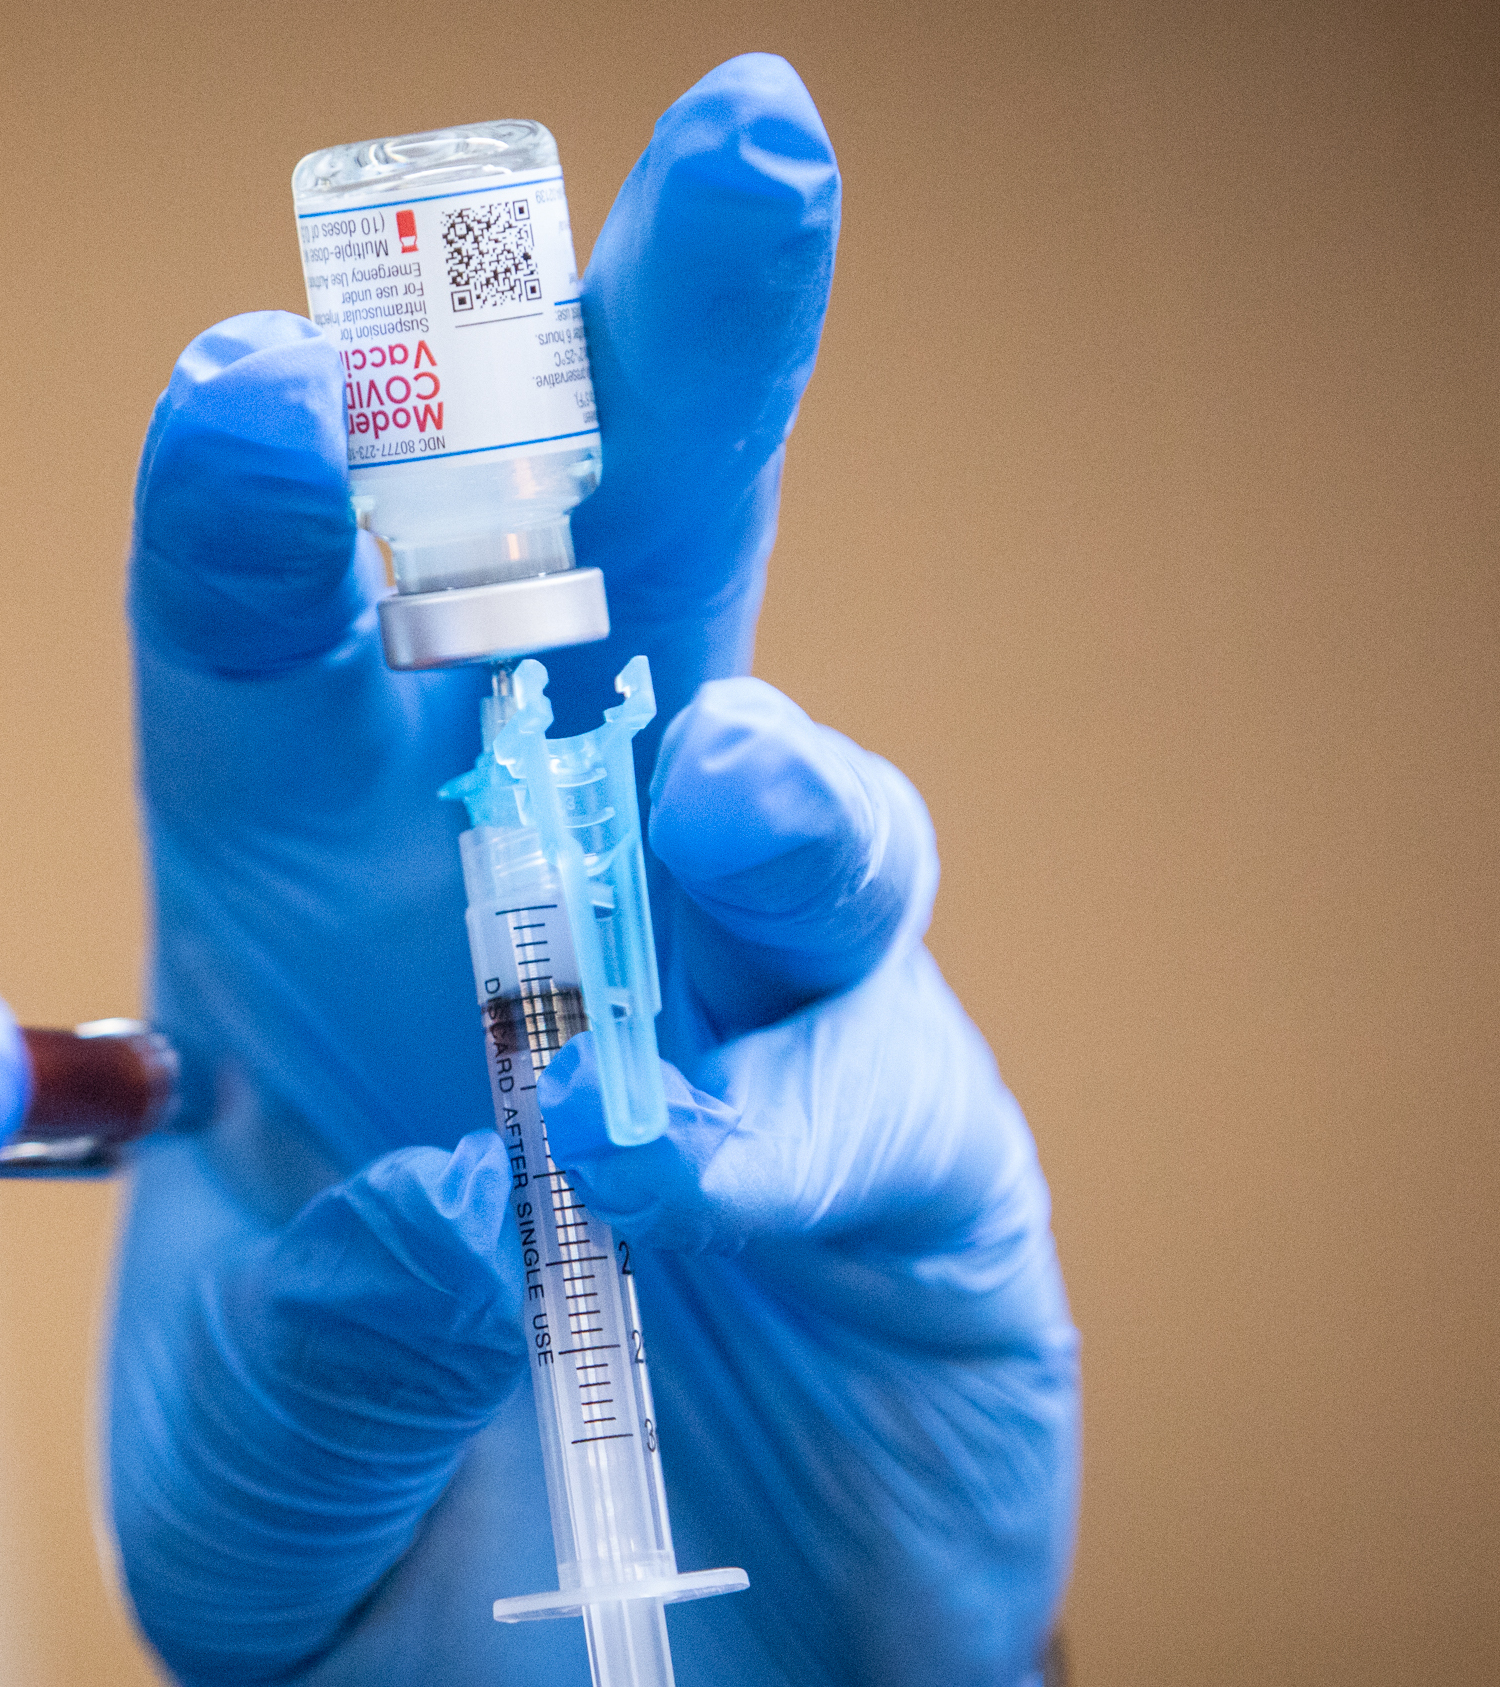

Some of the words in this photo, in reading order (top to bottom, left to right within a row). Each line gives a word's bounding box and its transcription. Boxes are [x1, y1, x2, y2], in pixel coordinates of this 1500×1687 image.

[321, 219, 357, 237] doses
[361, 211, 385, 235] (10
[309, 239, 389, 264] Multiple-dose
[331, 271, 349, 287] Use
[351, 262, 422, 281] Emergency
[342, 288, 372, 304] under
[376, 285, 399, 299] use
[403, 281, 425, 296] For
[342, 299, 427, 322] Intramuscular
[341, 327, 354, 341] for
[356, 318, 430, 339] Suspension
[535, 330, 565, 346] hours.
[339, 340, 438, 379] Vacci
[346, 371, 441, 410] COVID
[349, 402, 444, 439] Moder
[419, 436, 446, 452] NDC
[484, 977, 515, 1093] DISCARD
[502, 1107, 529, 1191] AFTER
[517, 1201, 544, 1301] SINGLE
[532, 1312, 554, 1367] USE
